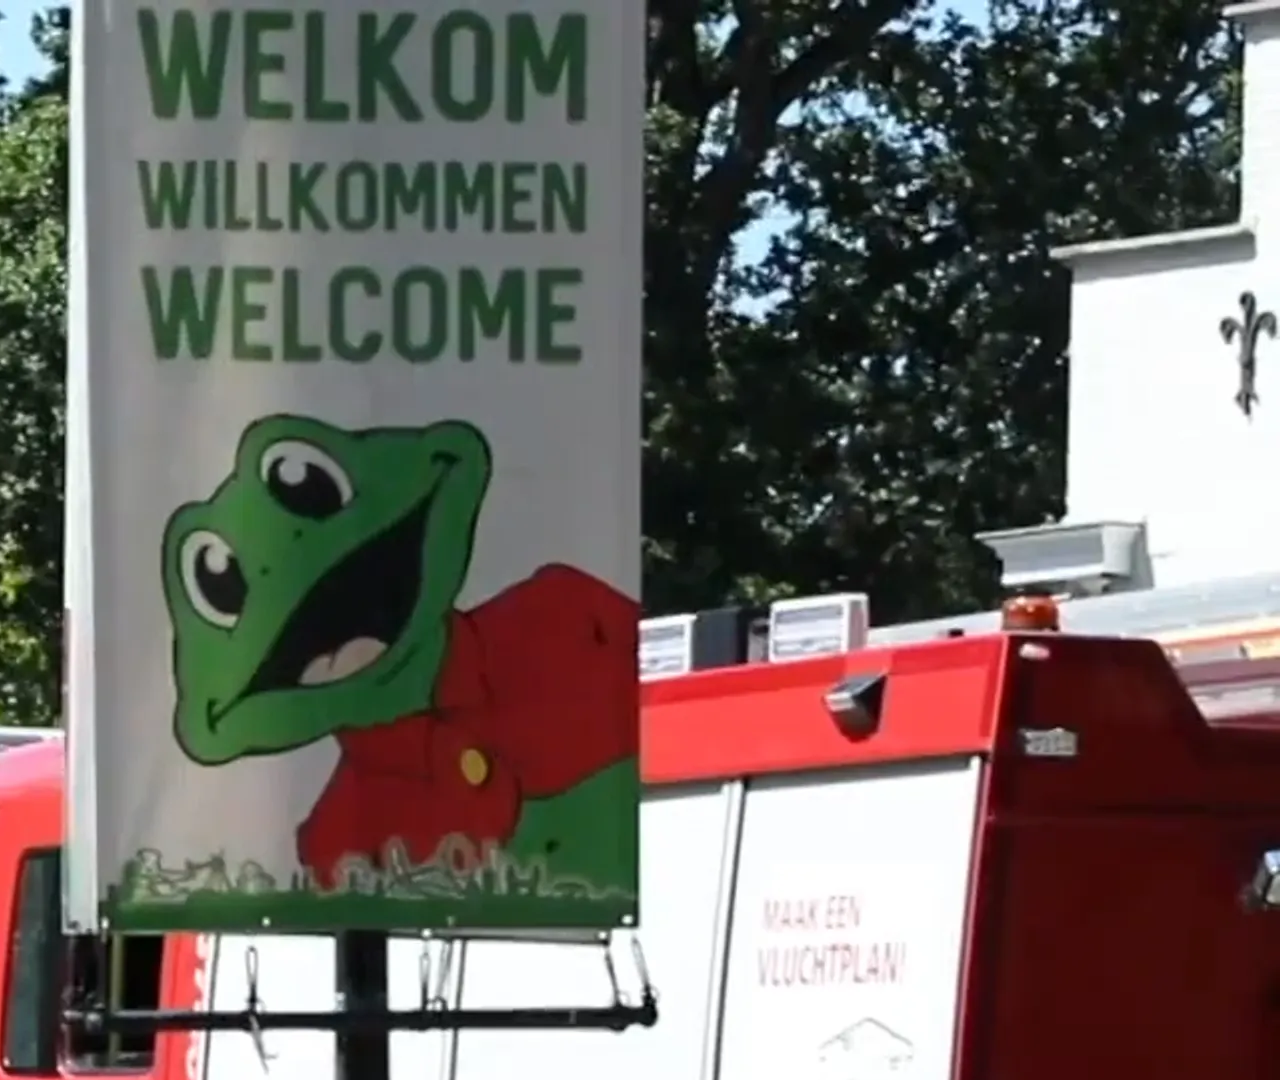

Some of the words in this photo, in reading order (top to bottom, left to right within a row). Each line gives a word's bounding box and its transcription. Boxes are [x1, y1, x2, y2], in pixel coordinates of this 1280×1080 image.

[137, 9, 588, 123] WELKOM
[137, 159, 588, 234] WILLKOMMEN
[142, 264, 584, 365] WELCOME
[763, 898, 819, 931] MAAK
[825, 894, 861, 929] EEN
[757, 941, 908, 987] VLUCHTPLAN!
